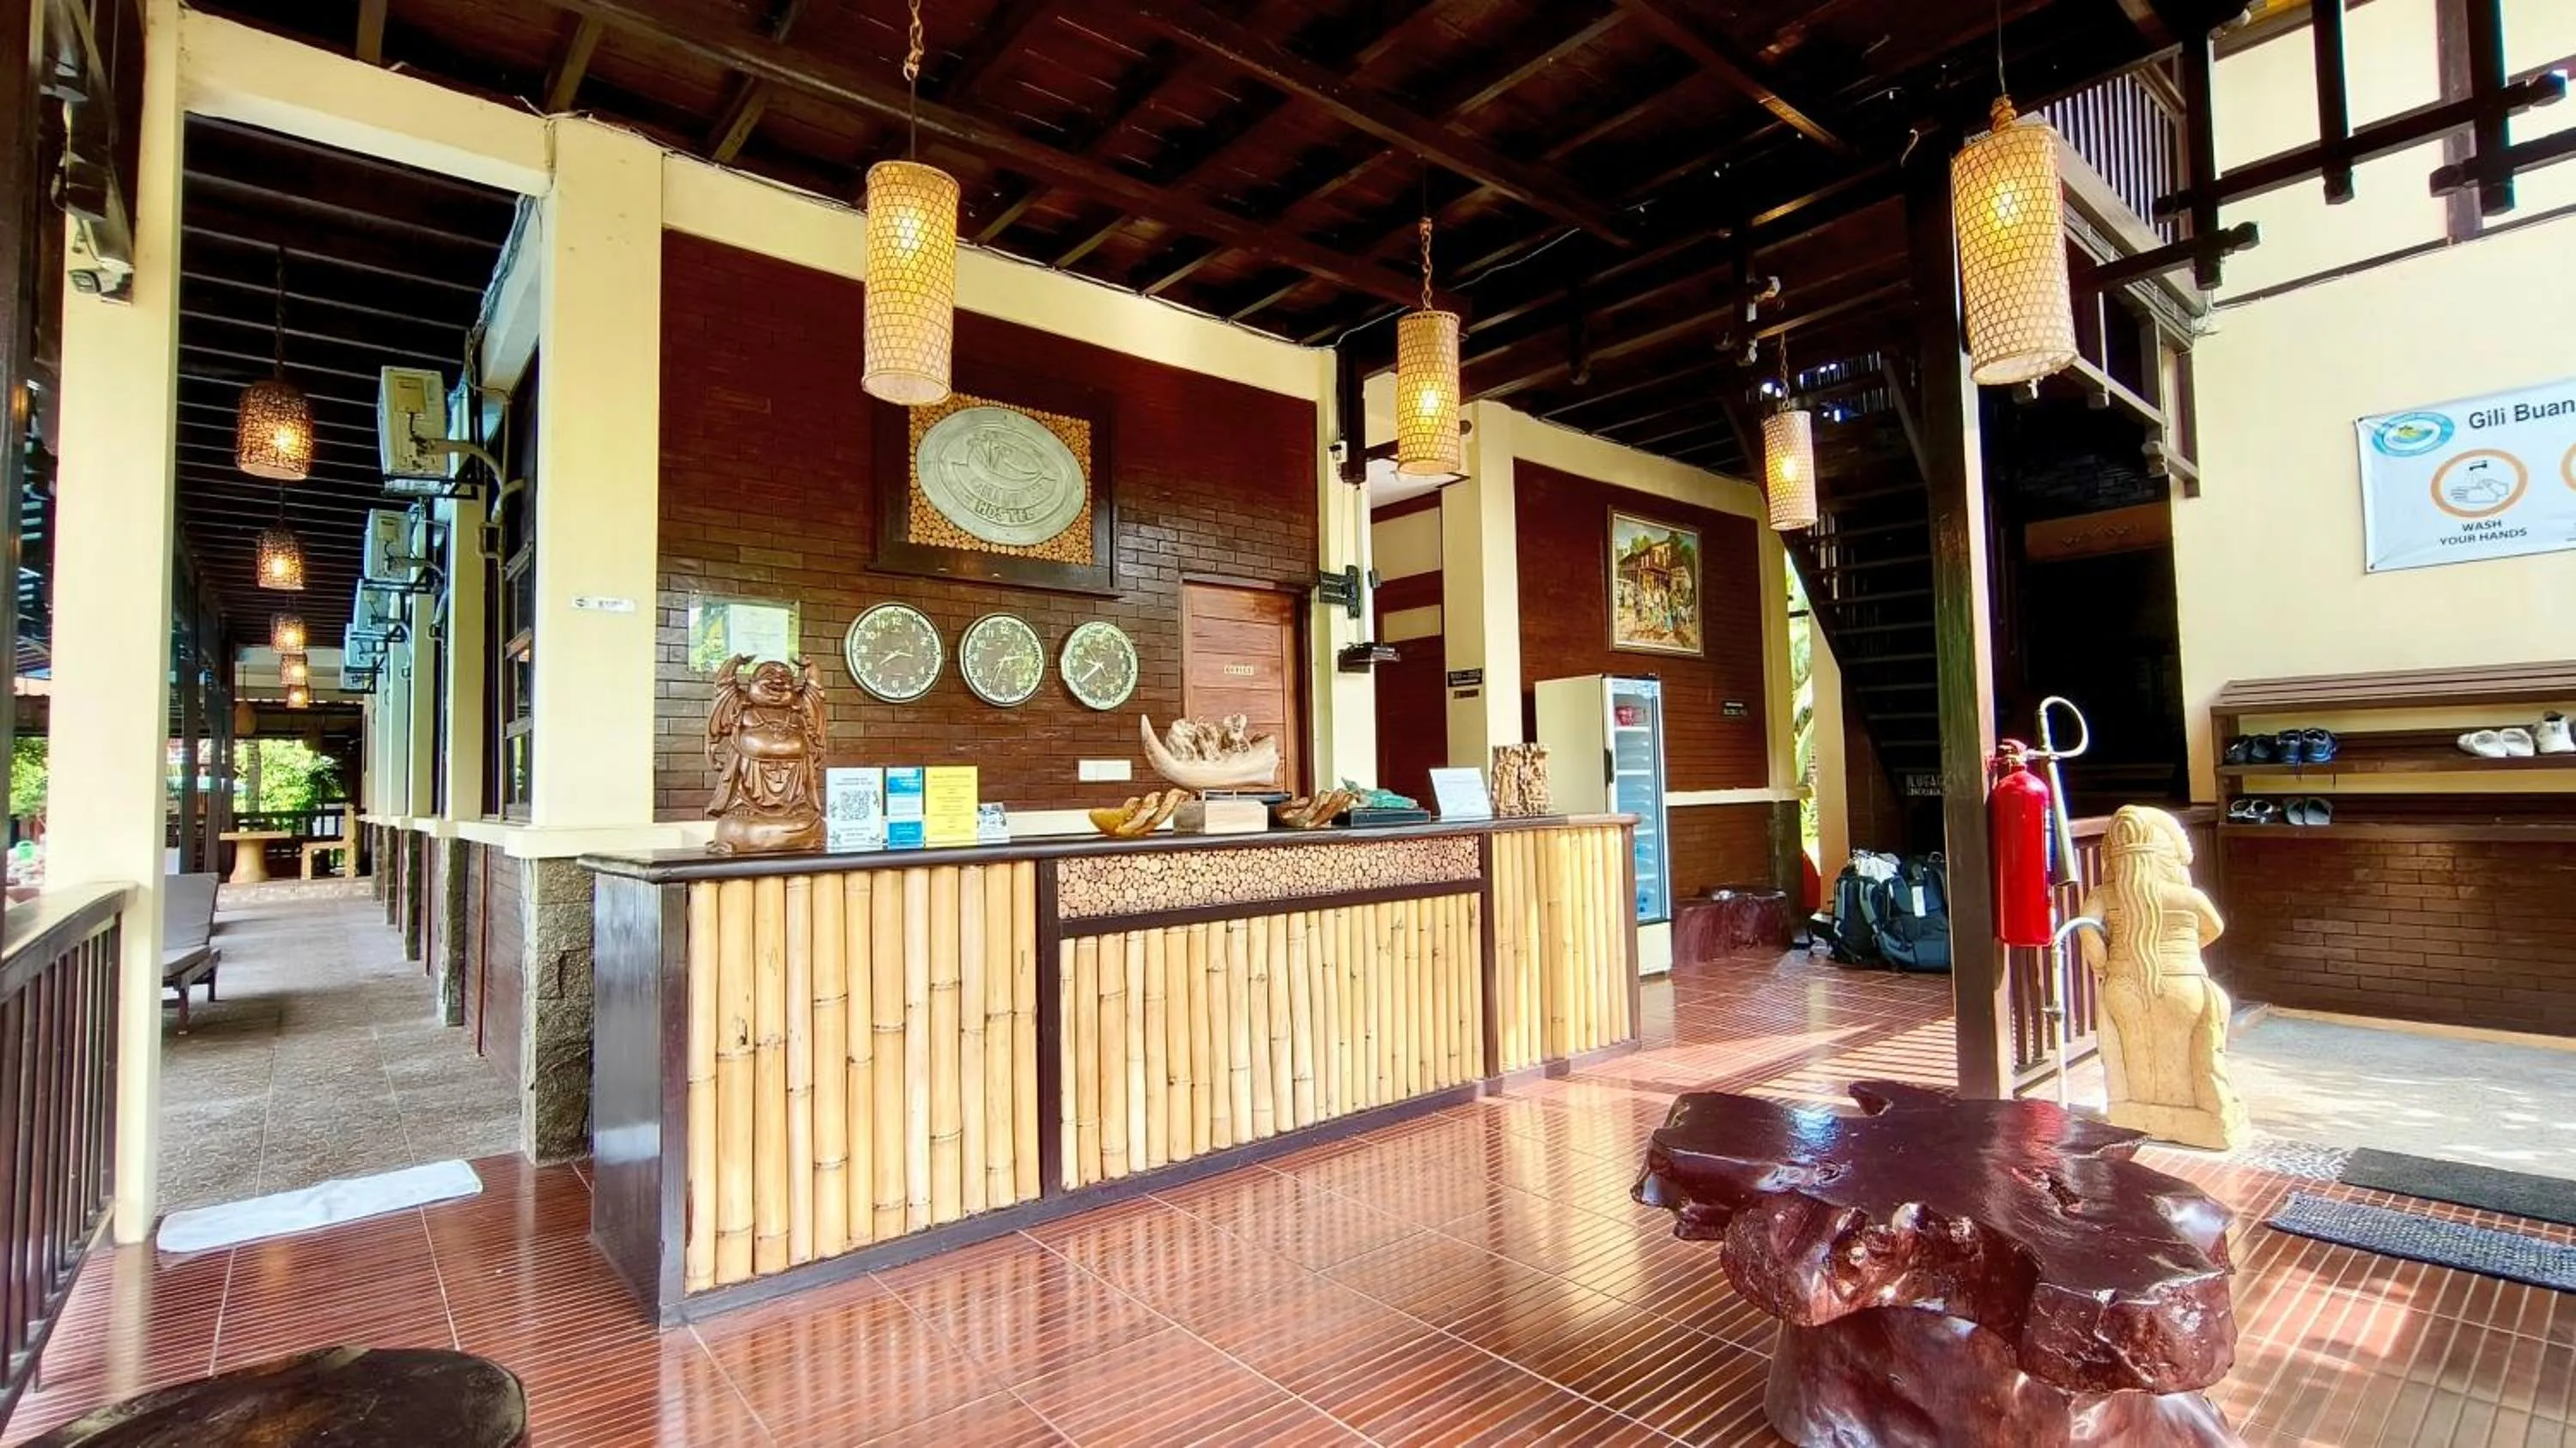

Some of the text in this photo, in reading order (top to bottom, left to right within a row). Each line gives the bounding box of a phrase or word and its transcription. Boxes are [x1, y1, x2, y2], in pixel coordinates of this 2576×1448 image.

[2469, 399, 2576, 429] Gili Buan
[2462, 519, 2502, 532] WASH
[2439, 527, 2528, 545] YOUR HANDS
